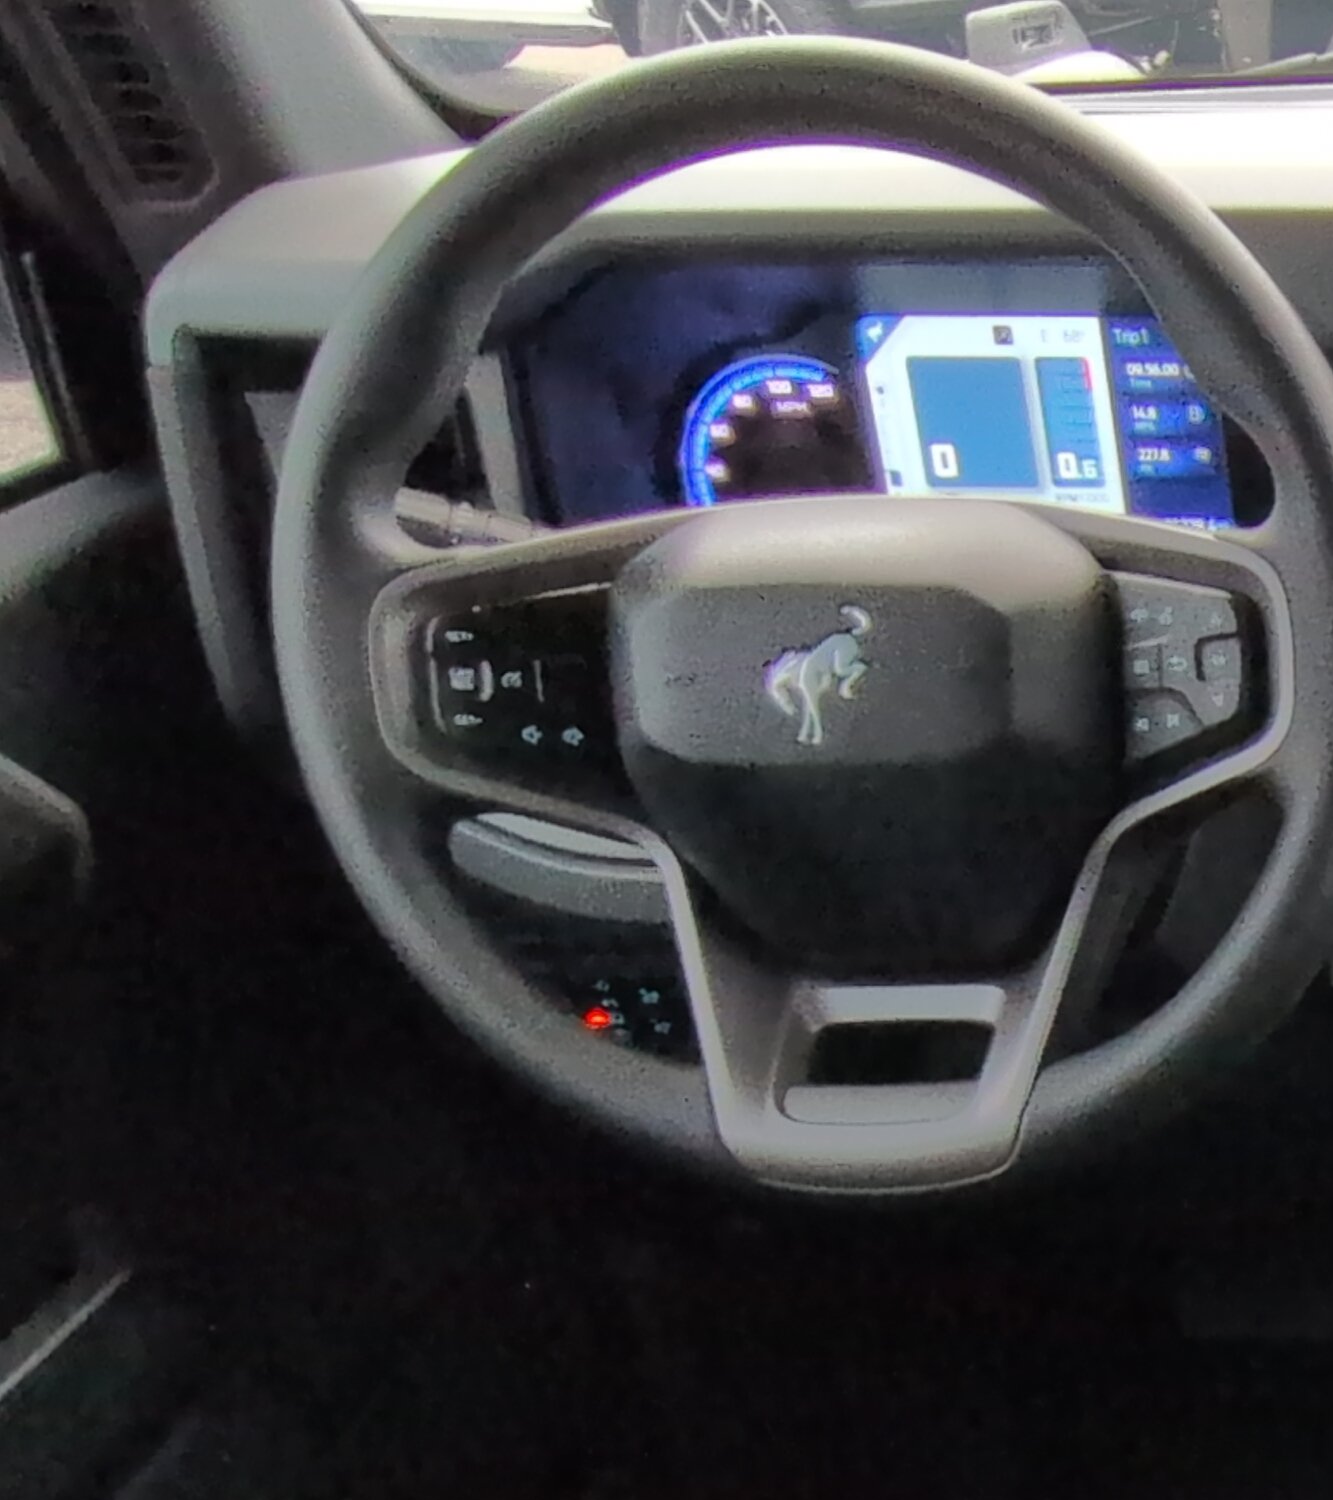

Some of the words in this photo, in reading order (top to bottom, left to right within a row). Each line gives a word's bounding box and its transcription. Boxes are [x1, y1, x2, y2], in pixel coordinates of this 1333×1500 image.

[1112, 328, 1140, 346] Trip
[765, 380, 792, 394] 100
[929, 443, 960, 479] 0
[1056, 452, 1098, 480] 0.6
